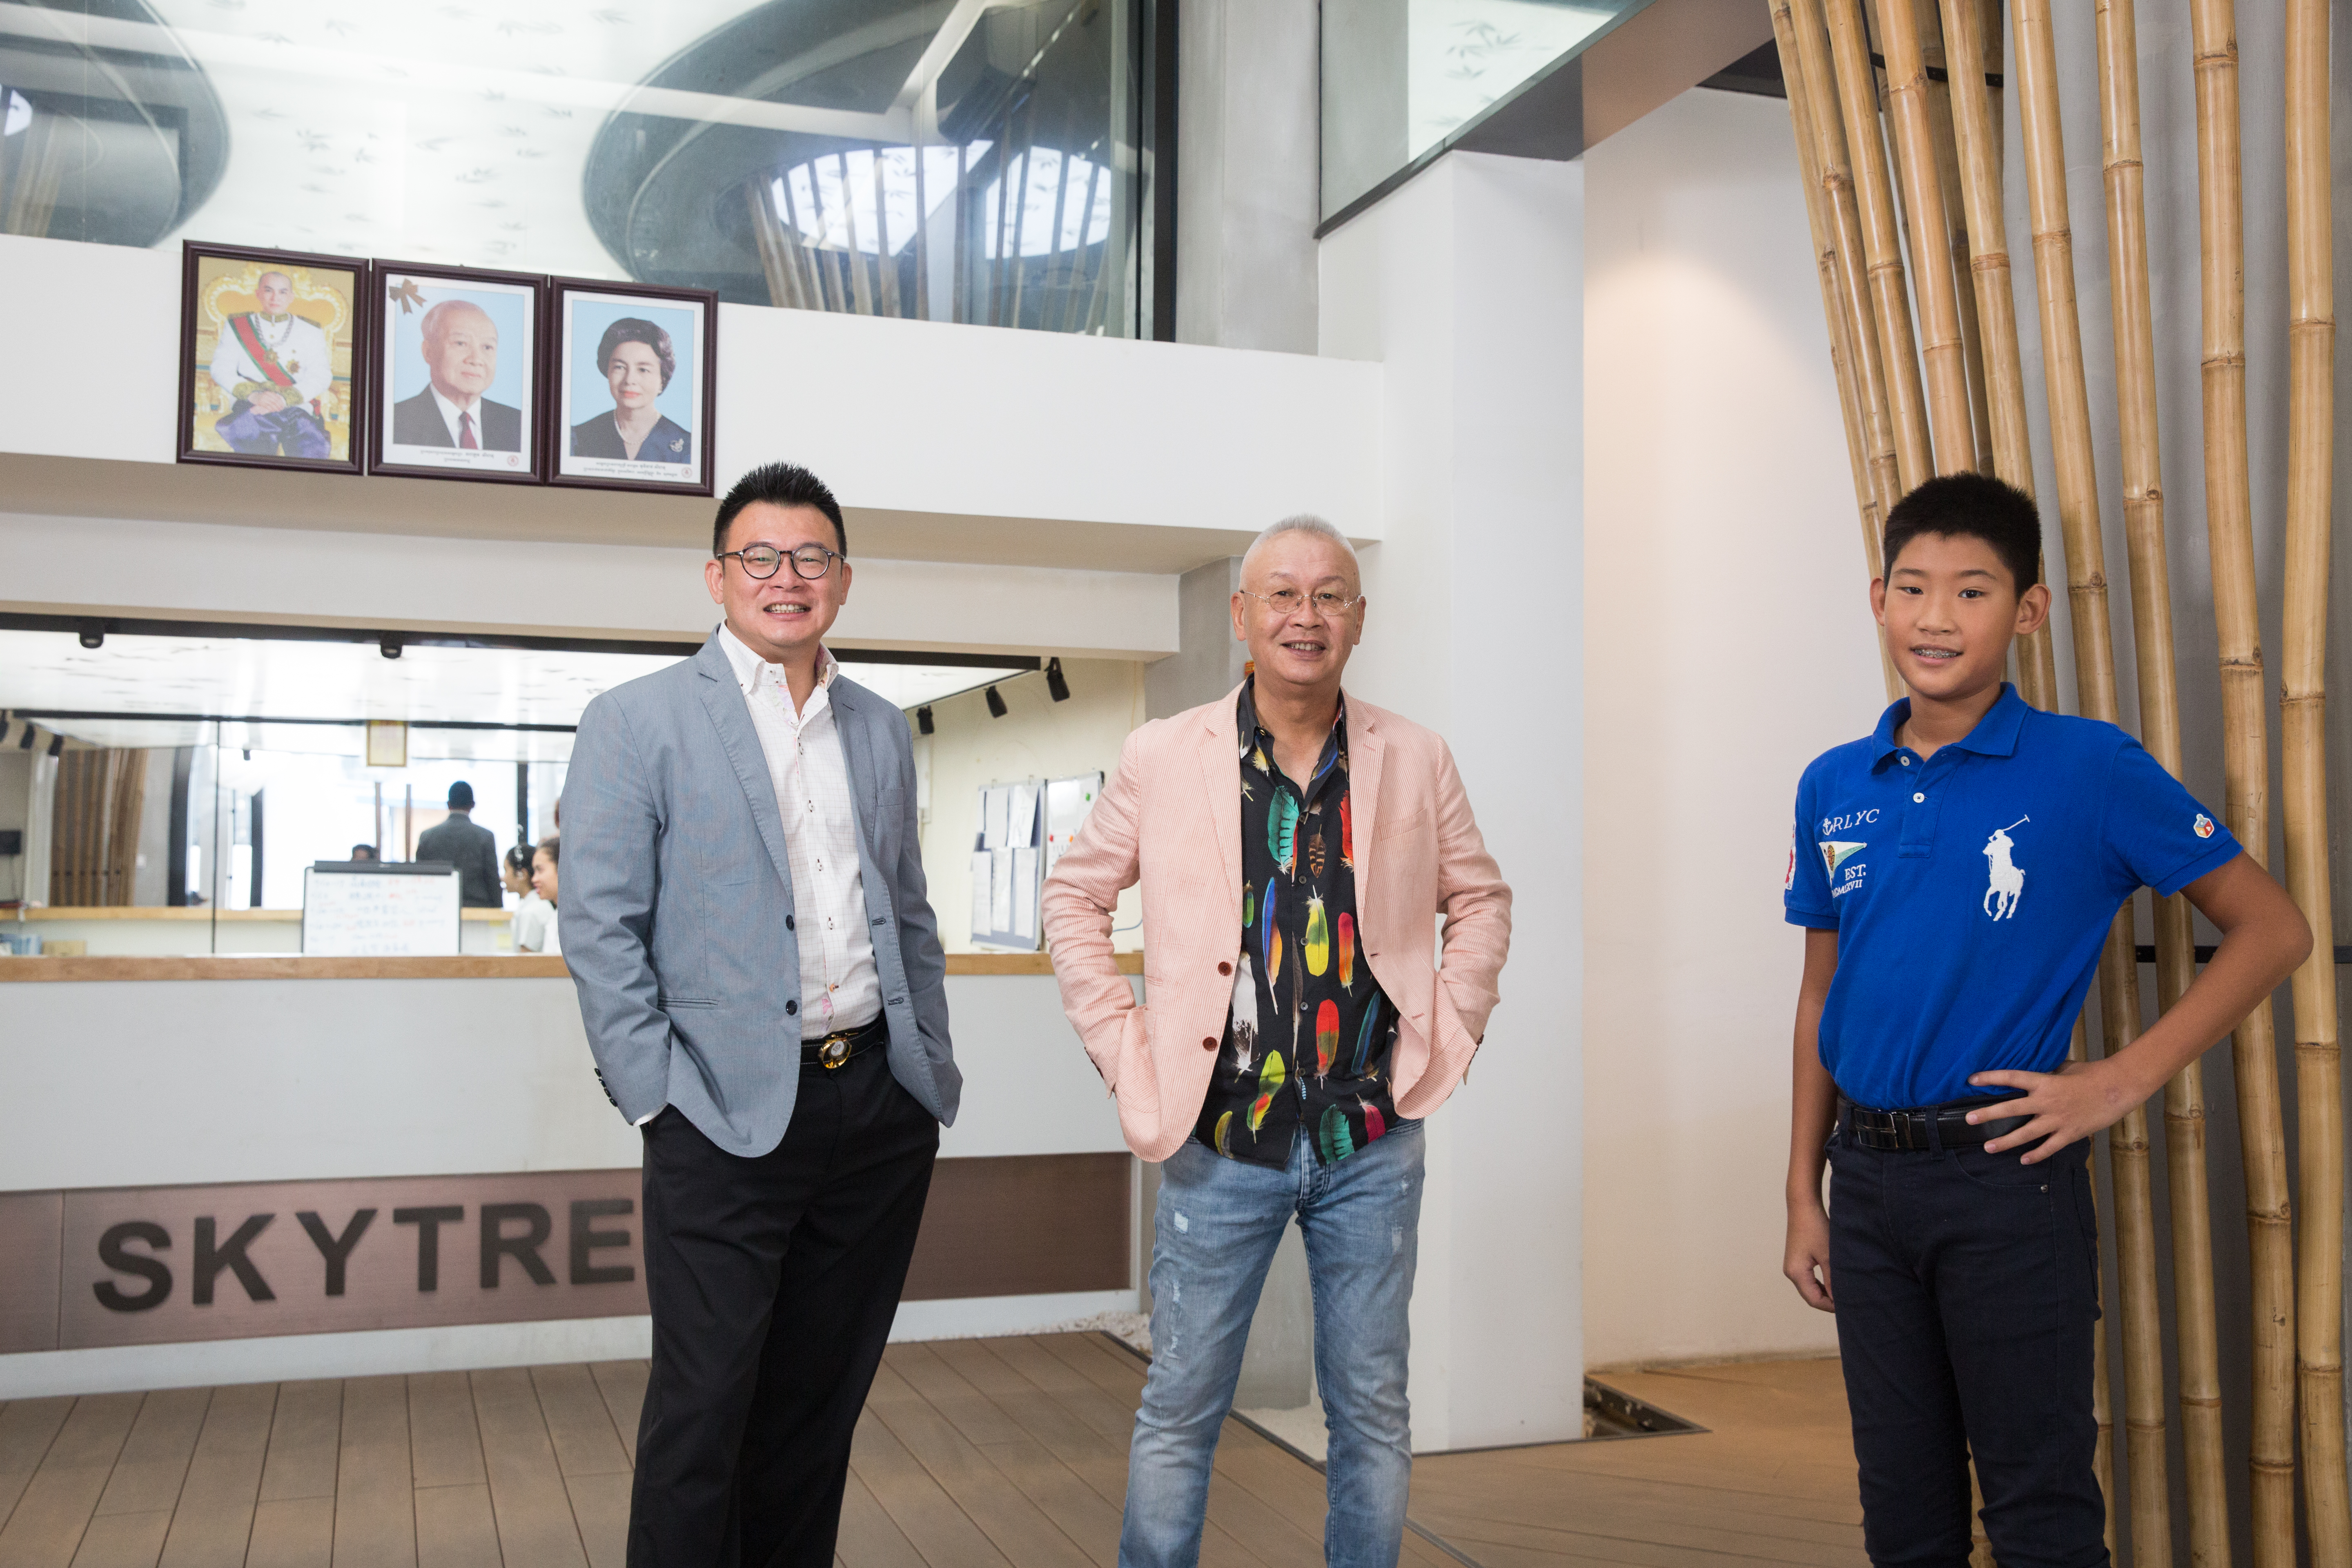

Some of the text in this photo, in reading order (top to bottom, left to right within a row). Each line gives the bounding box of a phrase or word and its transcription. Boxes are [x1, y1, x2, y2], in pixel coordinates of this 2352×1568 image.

[1833, 809, 1880, 832] RLYC
[1844, 864, 1866, 881] EST.
[93, 1198, 636, 1313] SKYTRE
